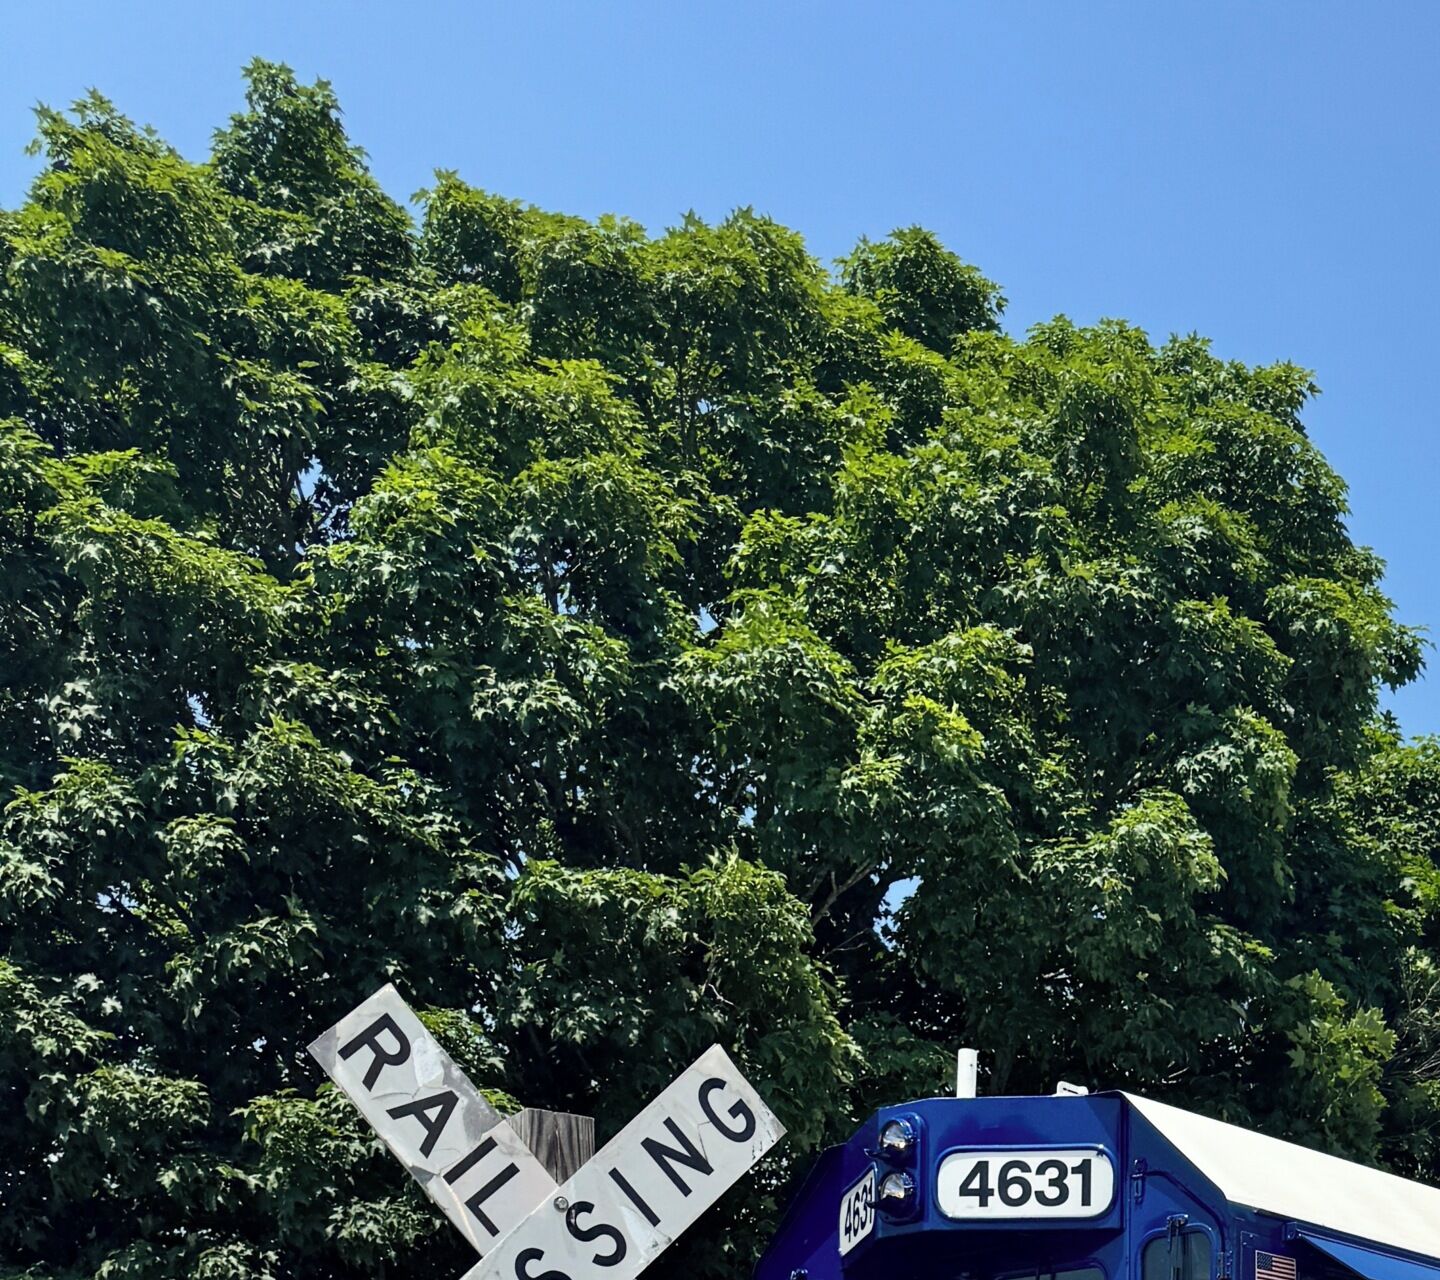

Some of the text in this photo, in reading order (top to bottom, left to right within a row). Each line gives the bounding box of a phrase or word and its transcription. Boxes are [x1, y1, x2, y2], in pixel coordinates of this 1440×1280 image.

[338, 1012, 520, 1238] RAIL
[844, 1176, 874, 1242] 4631
[958, 1158, 1093, 1208] 4631
